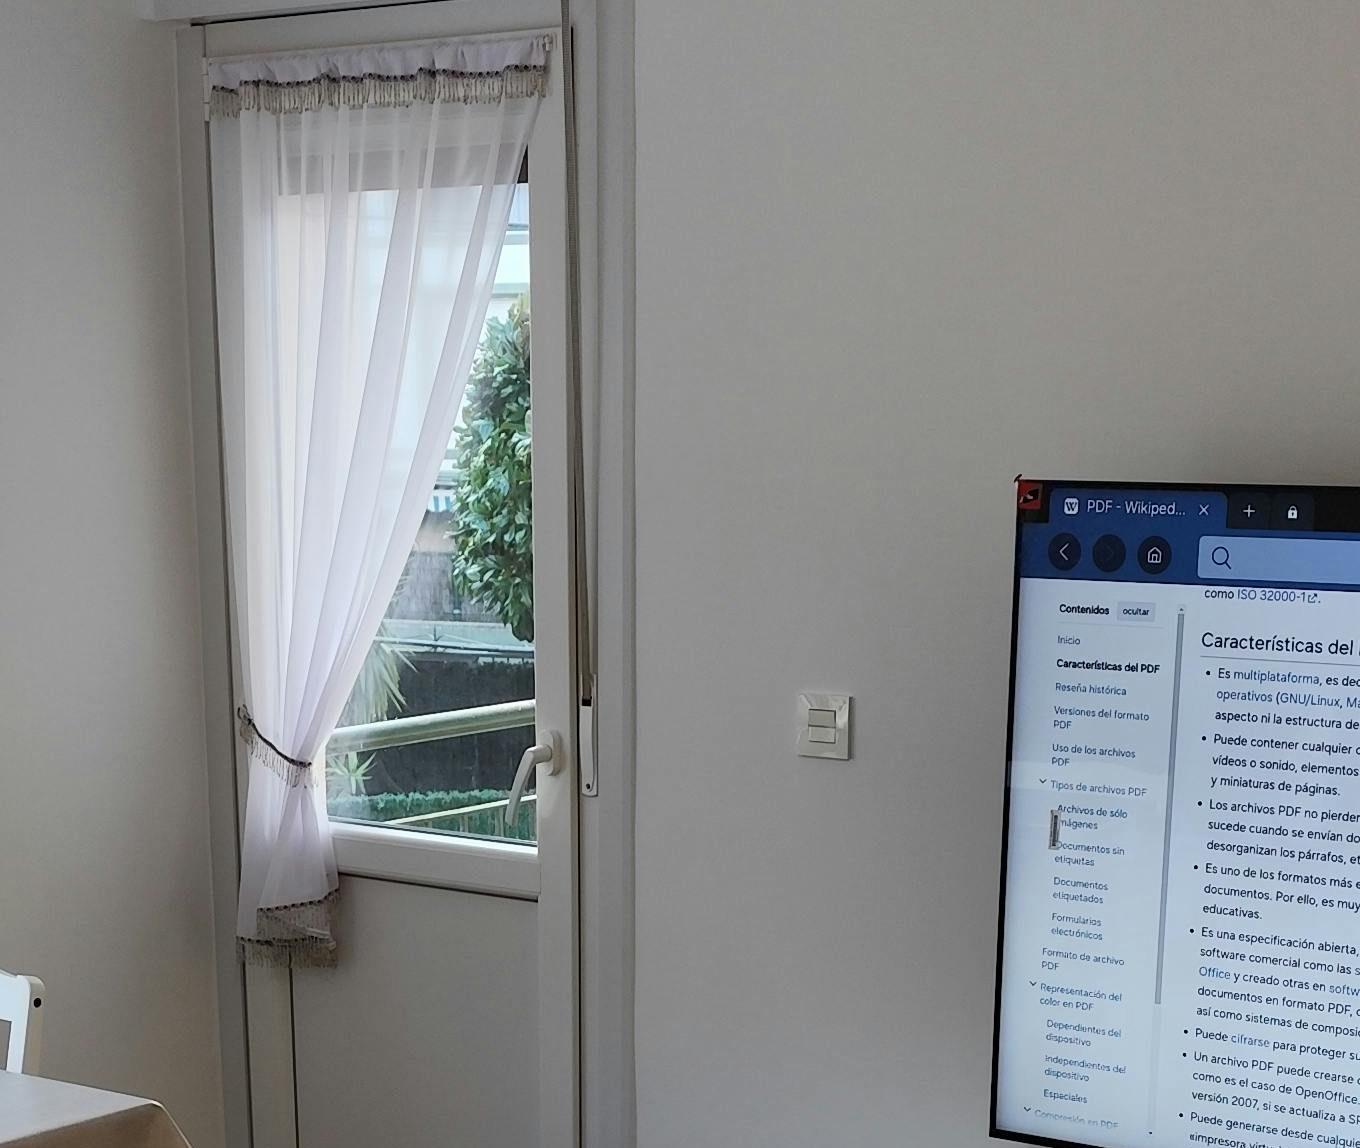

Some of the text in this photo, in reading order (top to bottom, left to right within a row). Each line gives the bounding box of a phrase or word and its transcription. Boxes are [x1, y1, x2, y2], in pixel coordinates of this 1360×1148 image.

[1087, 499, 1112, 512] PDF
[1204, 589, 1234, 599] como
[1237, 588, 1256, 600] ISO
[1201, 631, 1322, 653] Características
[1327, 639, 1353, 655] del
[1218, 667, 1230, 678] Es
[1233, 669, 1322, 686] multiplataforma,
[1325, 676, 1338, 685] es
[1213, 733, 1247, 746] Puede
[1250, 738, 1299, 749] contener
[1301, 741, 1352, 755] cualquier
[1201, 926, 1213, 937] Es
[1216, 930, 1235, 940] una
[1238, 933, 1314, 949] especificación
[1317, 941, 1358, 957] abierta,
[1195, 1027, 1228, 1041] Puede
[1230, 1034, 1269, 1047] cifrarse
[1272, 1041, 1296, 1051] para
[1299, 1045, 1346, 1060] proteger
